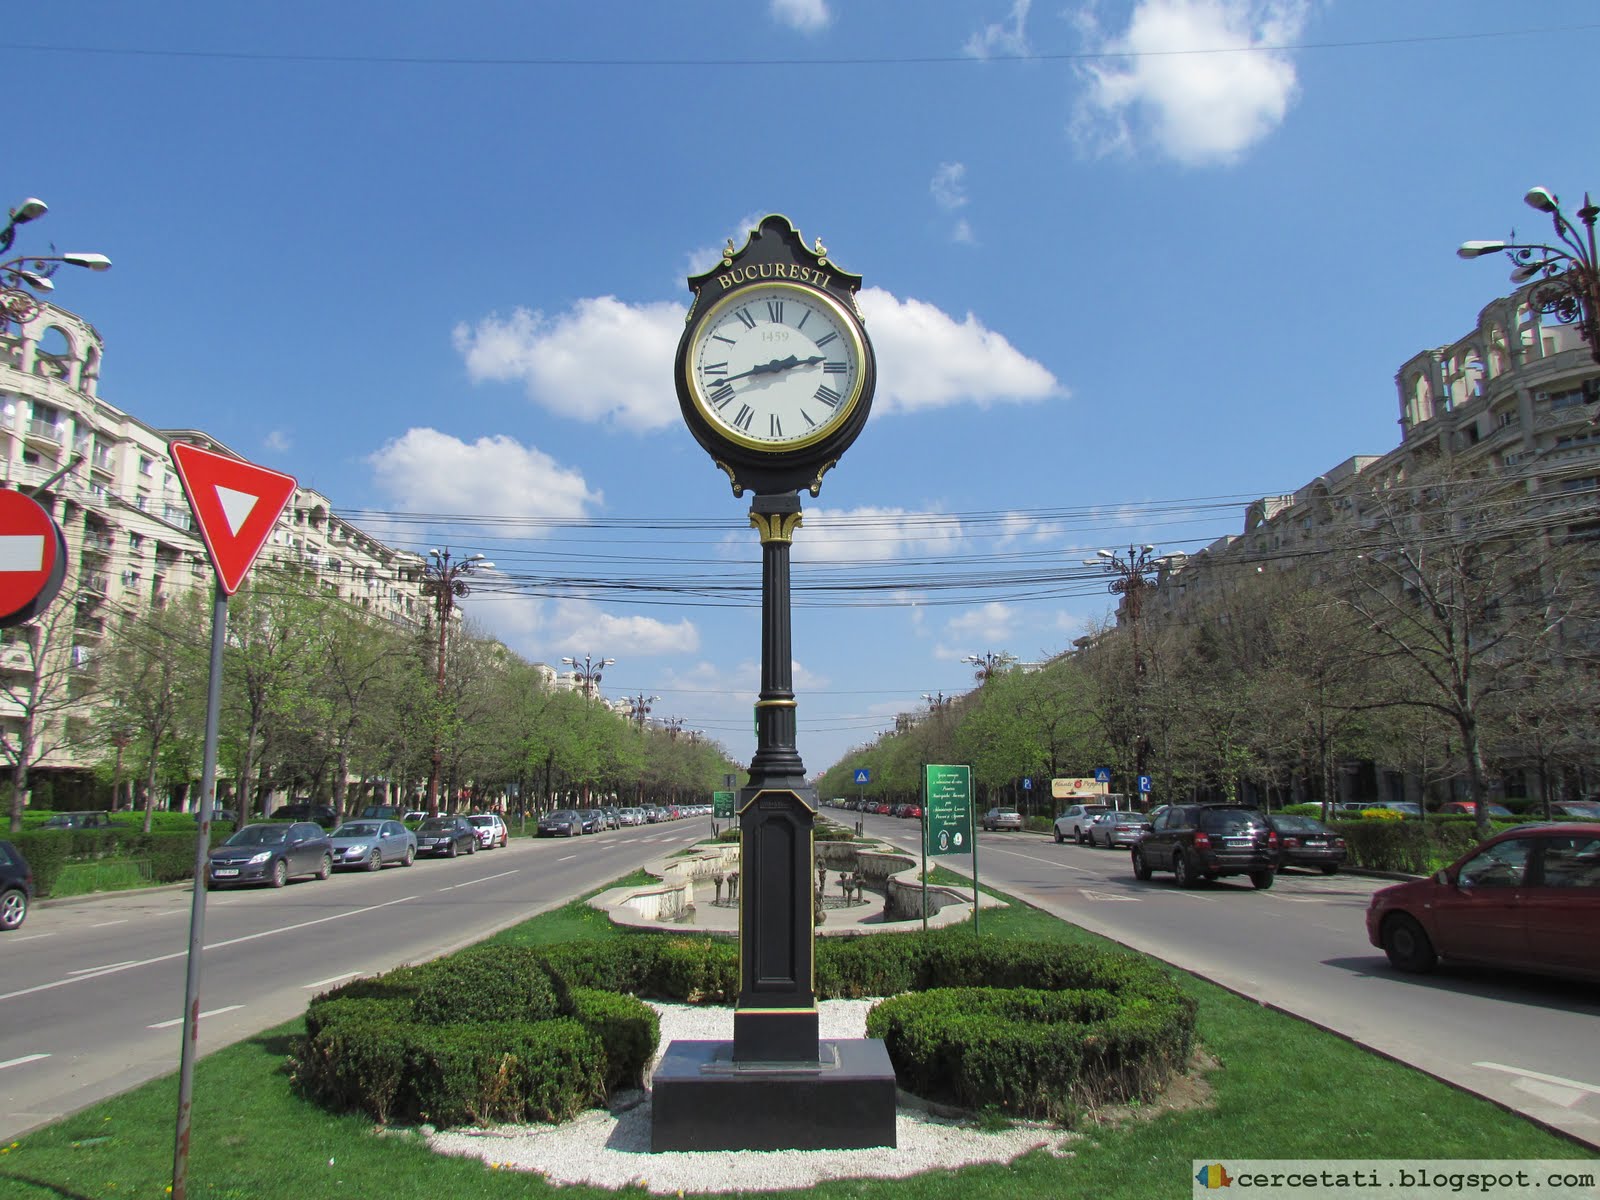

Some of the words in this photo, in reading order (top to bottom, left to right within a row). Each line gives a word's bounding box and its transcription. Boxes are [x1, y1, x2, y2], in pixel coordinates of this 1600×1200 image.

[717, 263, 831, 289] BUCURESTI
[735, 307, 757, 333] XI
[765, 301, 783, 323] XII
[797, 309, 812, 329] I
[712, 329, 737, 351] X
[761, 331, 789, 342] 1459
[815, 331, 838, 348] II
[703, 359, 728, 377] IX
[822, 360, 848, 375] III
[709, 382, 736, 410] VIII
[811, 384, 842, 409] IIII
[733, 402, 755, 431] VII
[768, 413, 783, 437] VI
[800, 407, 816, 429] V
[1140, 776, 1148, 790] P
